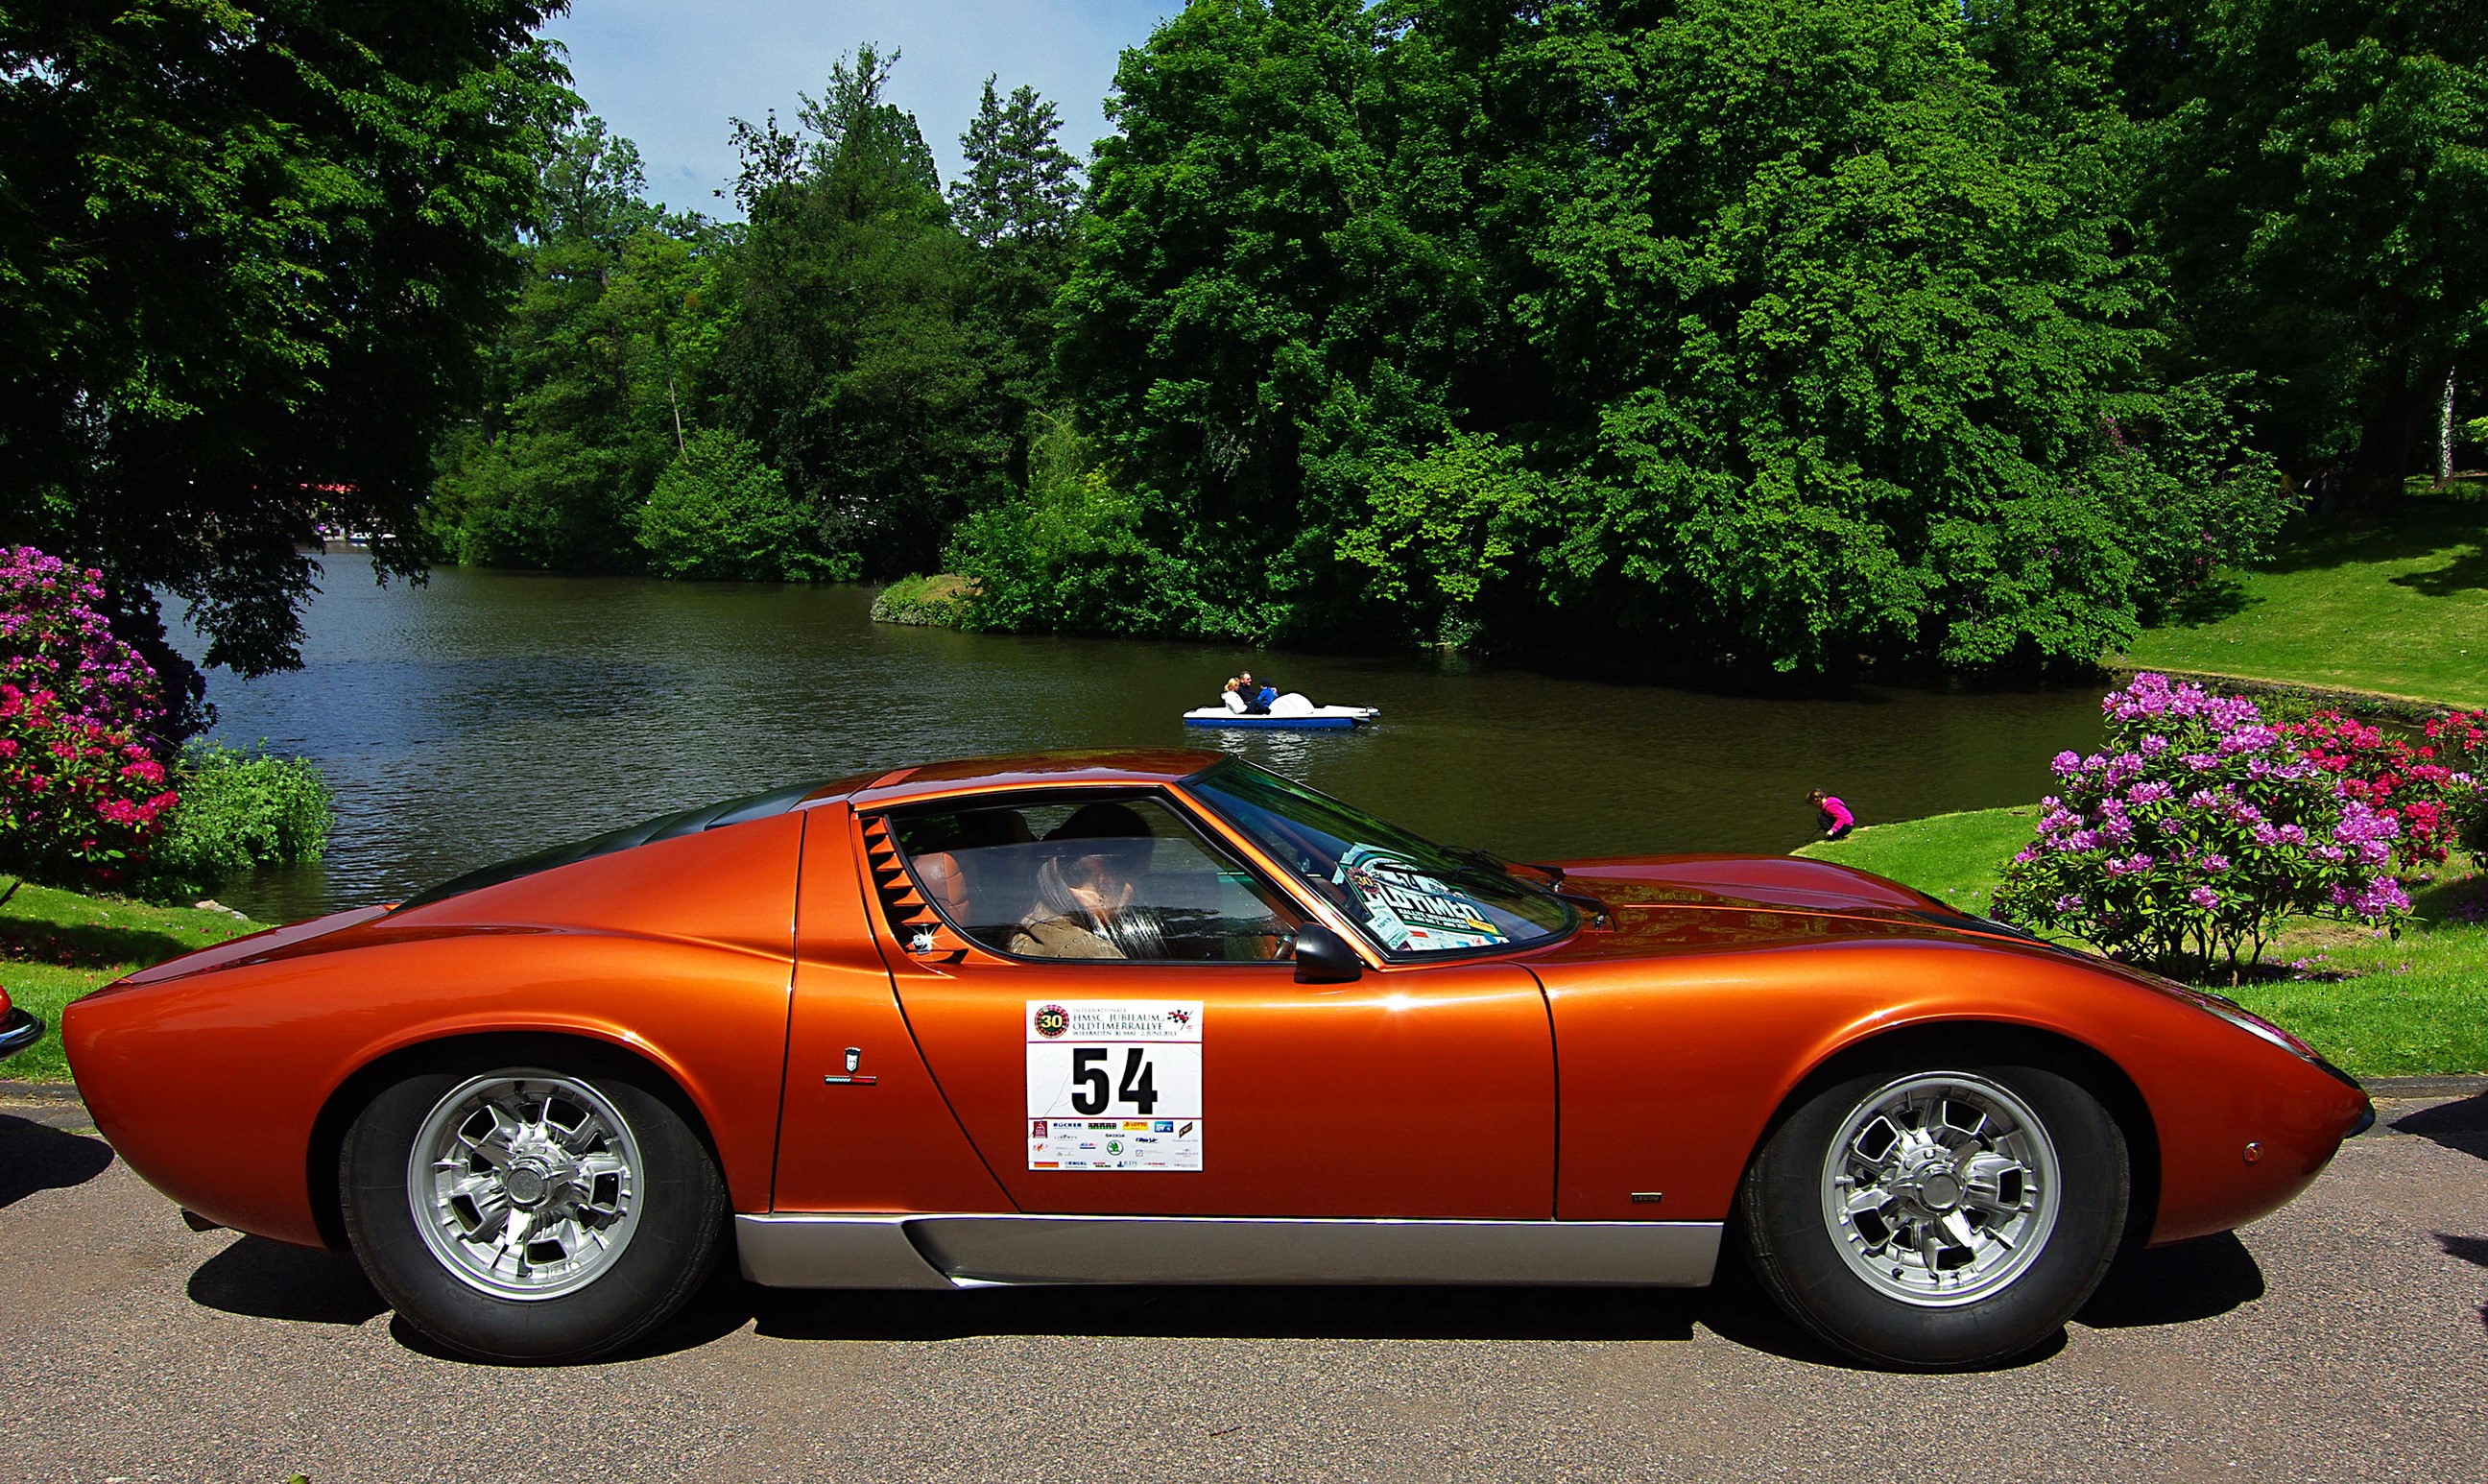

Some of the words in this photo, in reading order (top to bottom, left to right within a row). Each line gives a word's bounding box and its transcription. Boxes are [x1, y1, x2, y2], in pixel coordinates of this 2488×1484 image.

[1354, 874, 1374, 887] 30
[1041, 1015, 1063, 1028] 30
[1073, 1014, 1104, 1022] HMSC
[1072, 1022, 1163, 1031] OLDTIMERRALLYE
[1071, 1048, 1158, 1115] 54
